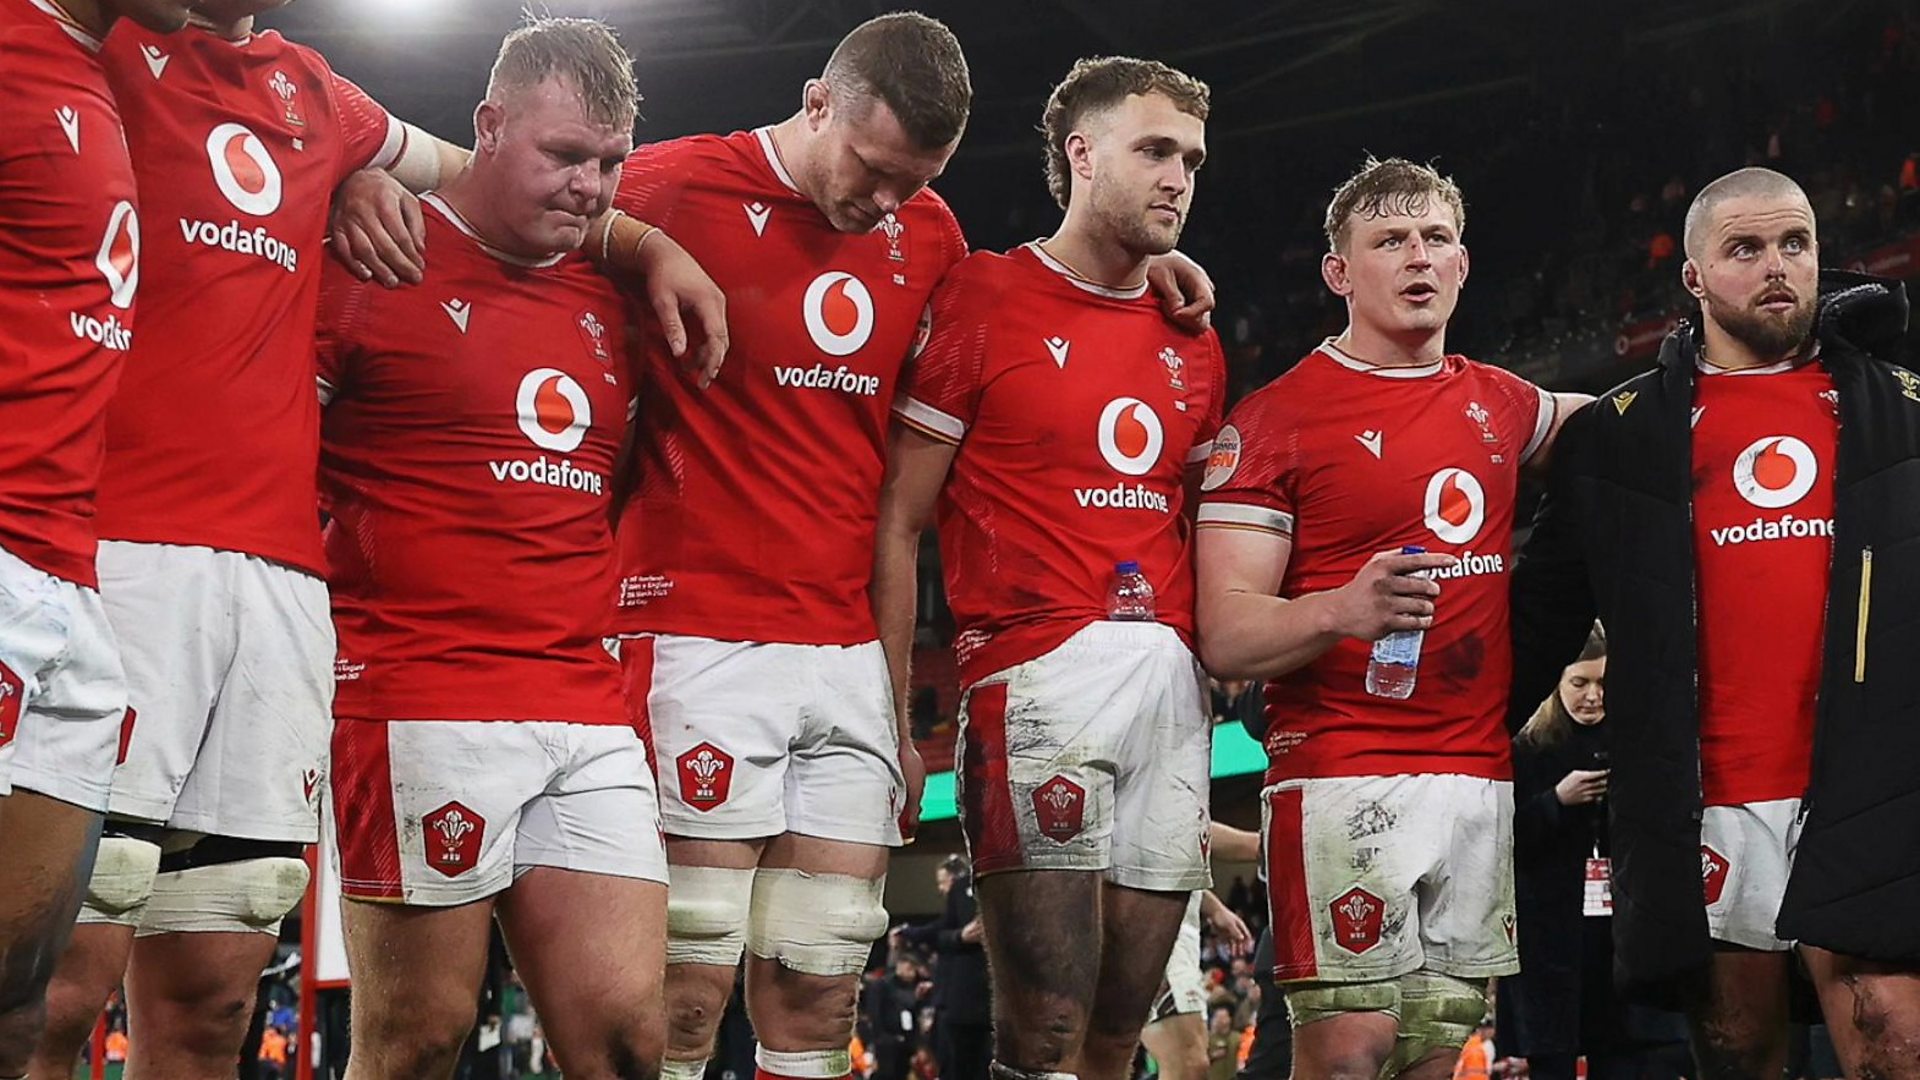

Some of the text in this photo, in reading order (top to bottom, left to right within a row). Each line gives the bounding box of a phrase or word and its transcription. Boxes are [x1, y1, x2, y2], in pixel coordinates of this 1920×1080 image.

[179, 217, 297, 272] vodafone
[773, 362, 880, 396] vodafone
[488, 455, 602, 496] vodafone
[1073, 481, 1169, 513] vodafone
